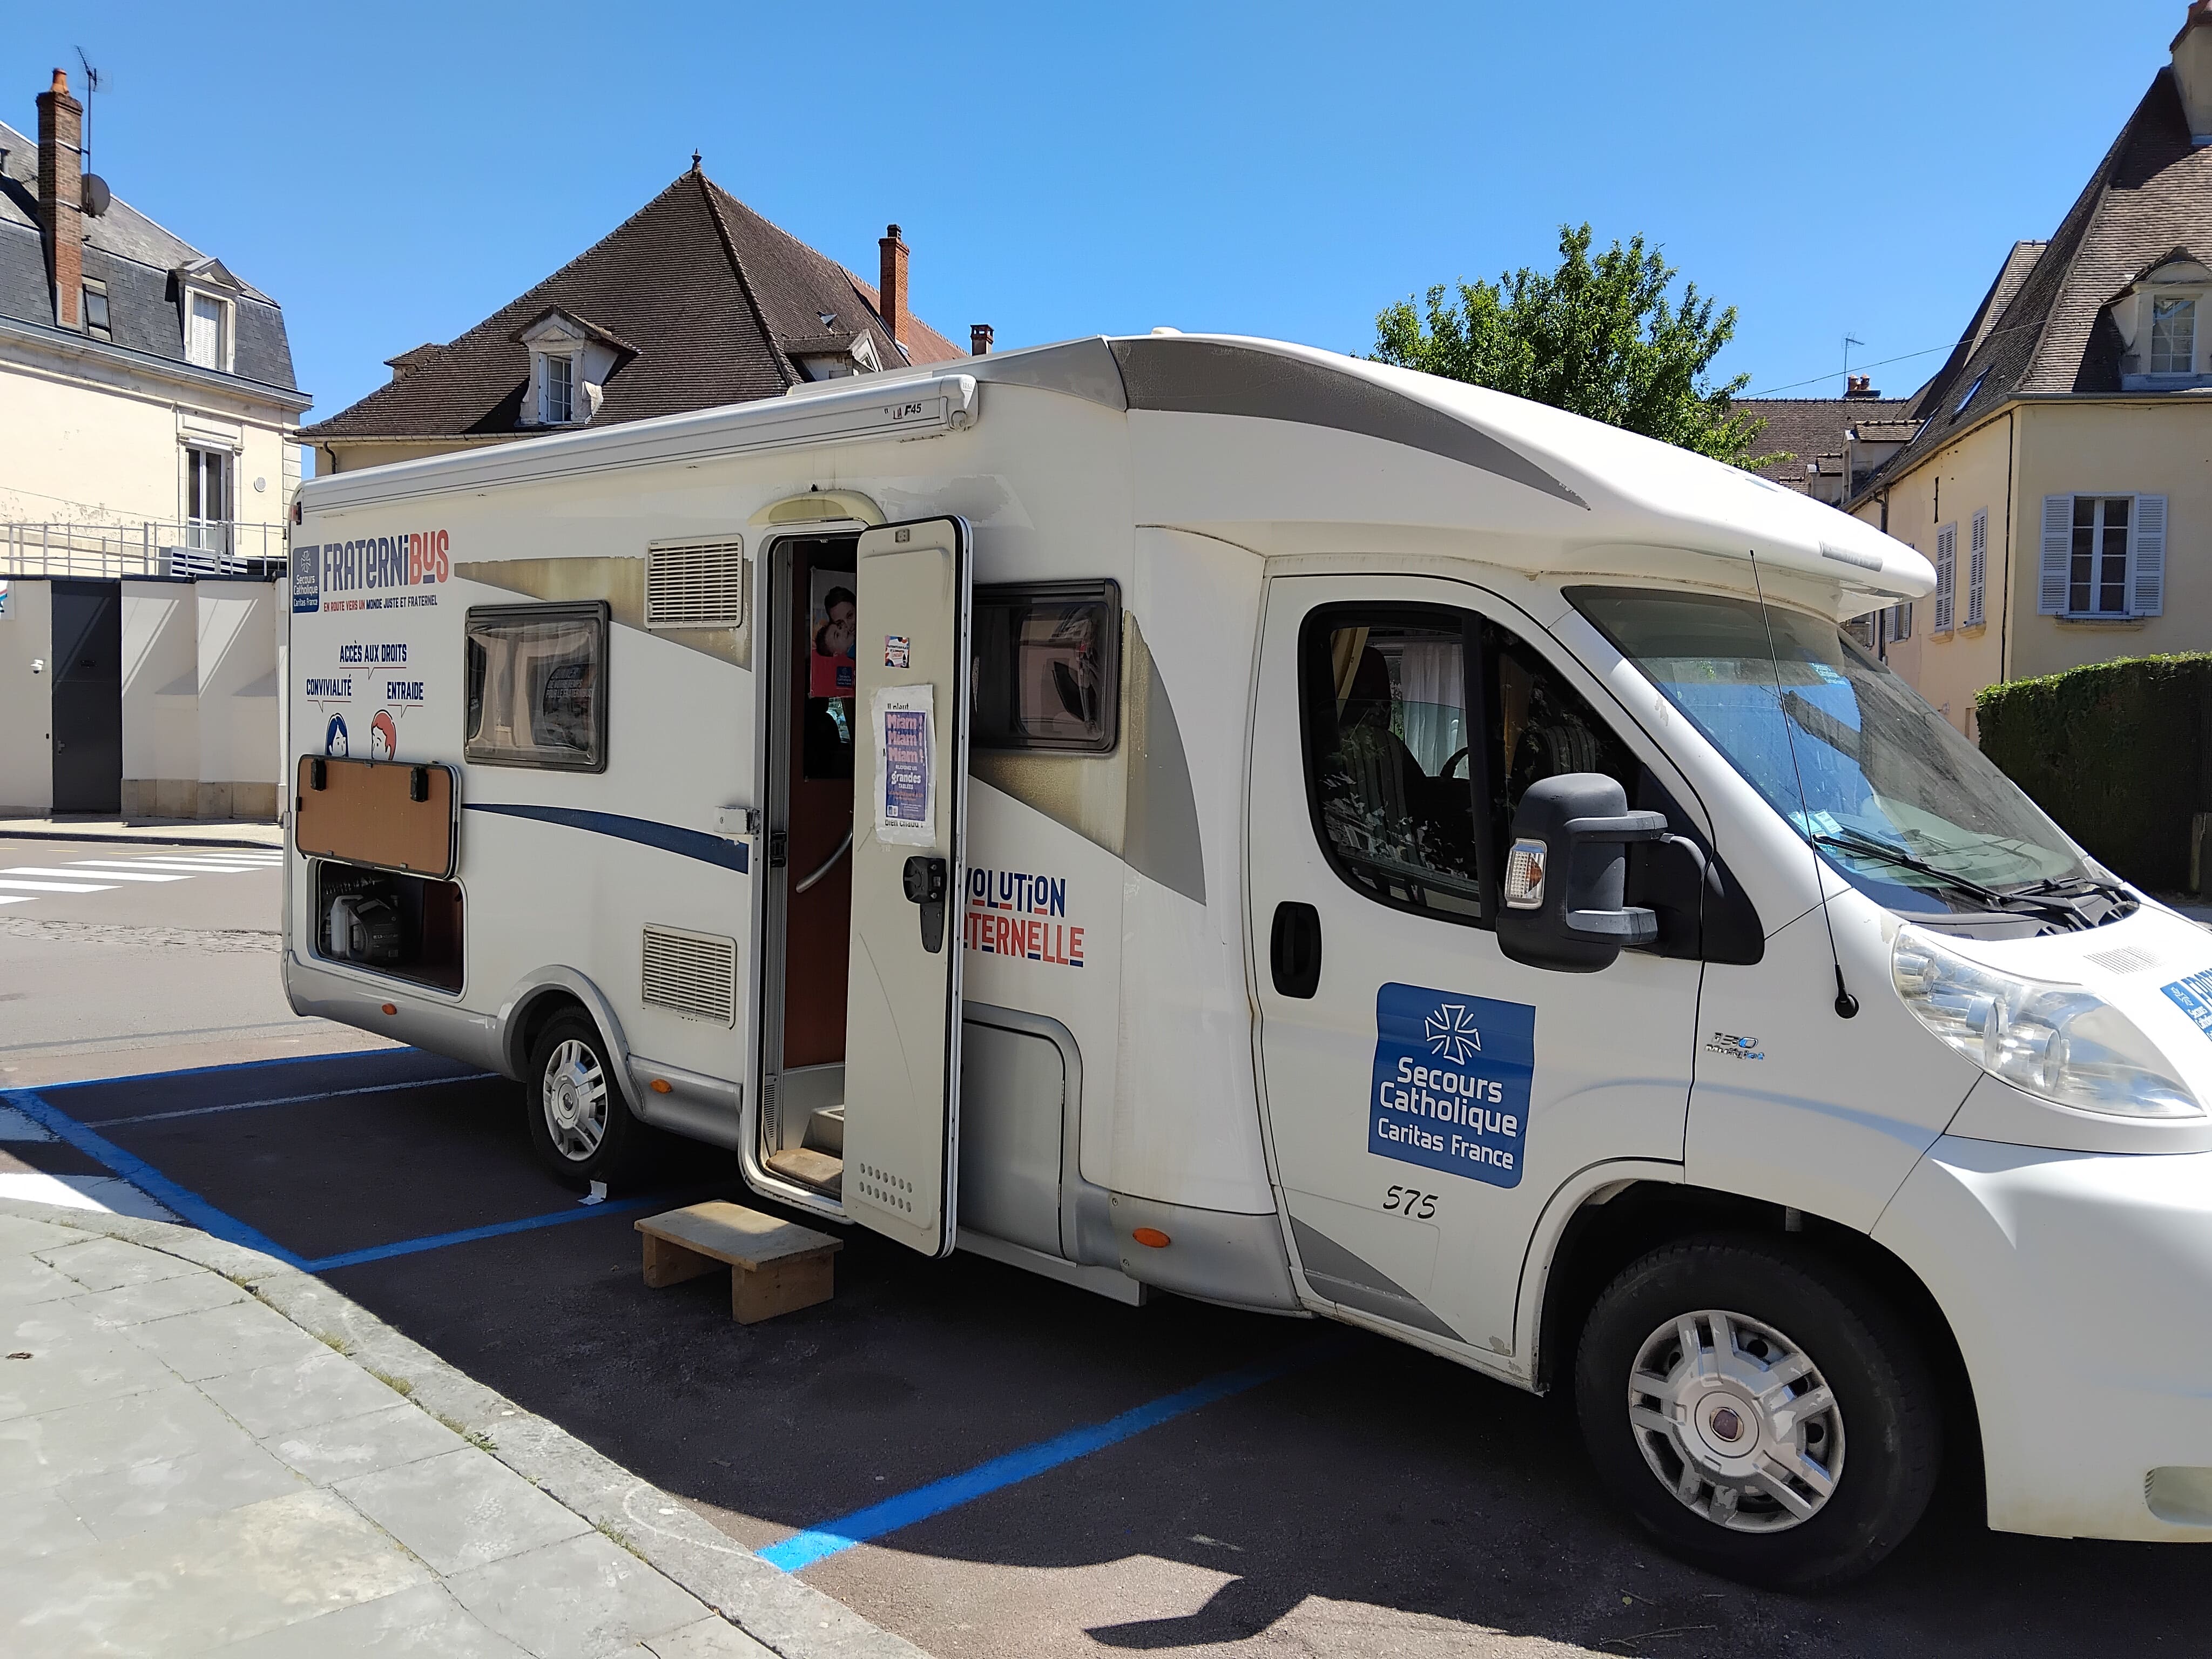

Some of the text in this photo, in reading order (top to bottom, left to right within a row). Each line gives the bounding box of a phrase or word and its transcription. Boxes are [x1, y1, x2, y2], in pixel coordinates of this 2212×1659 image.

[296, 575, 315, 584] Secours
[294, 584, 318, 596] Catholique
[324, 595, 437, 612] EN ROUTE VERS UN MONDE JUSTE ET FRATERNEL
[340, 640, 407, 662] ACCÈS AUX DROITS
[307, 673, 352, 696] CONVIVIALITÉ
[387, 682, 423, 700] ENTRAIDE
[887, 714, 922, 730] Miam !
[888, 731, 922, 746] Miam !
[888, 747, 918, 763] Miam
[919, 748, 923, 764] !
[892, 771, 921, 784] grandes
[964, 912, 1084, 966] TERNELLE
[1712, 1032, 1758, 1048] 130
[1398, 1057, 1502, 1103] Secours
[1380, 1081, 1518, 1137] Catholique
[1378, 1118, 1514, 1170] Caritas France
[1382, 1185, 1439, 1219] 575
